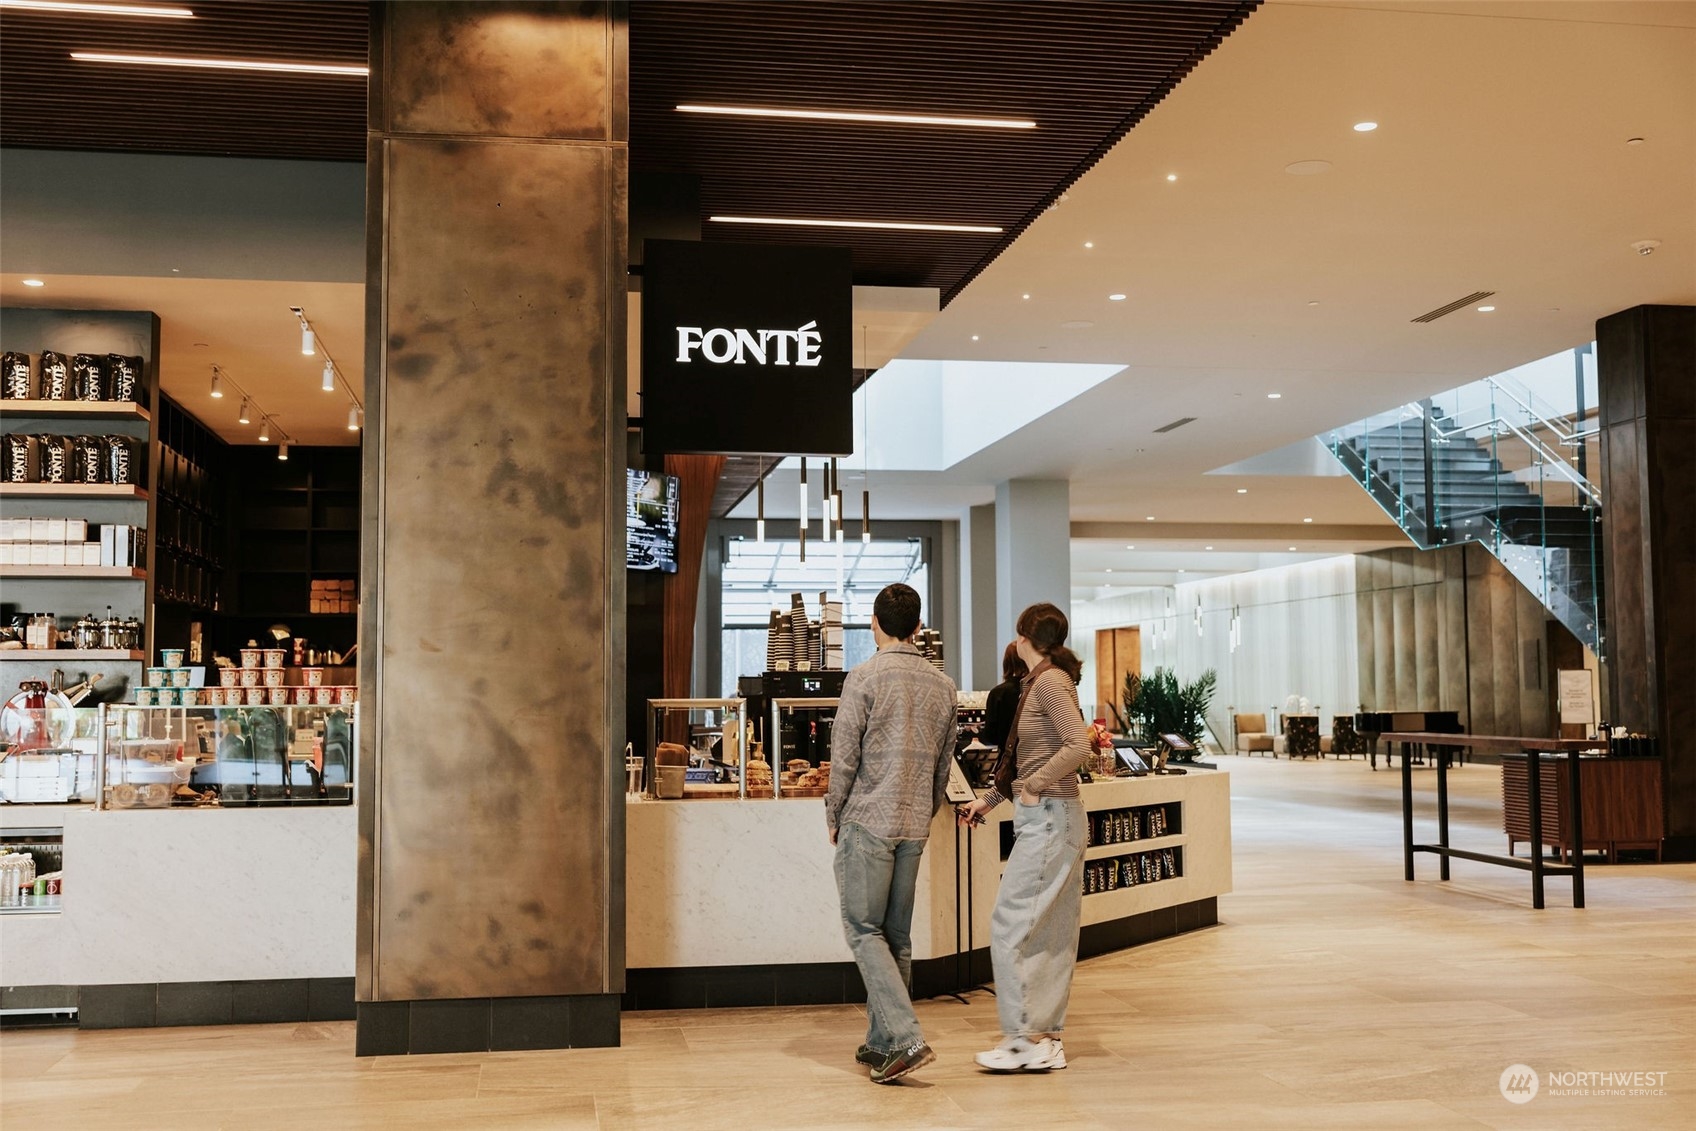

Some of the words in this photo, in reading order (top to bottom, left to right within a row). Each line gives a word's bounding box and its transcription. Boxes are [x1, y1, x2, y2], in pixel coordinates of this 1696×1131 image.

[676, 320, 822, 367] FONTÉ
[13, 364, 26, 399] FONTÉ
[50, 365, 63, 399] FONTÉ
[87, 366, 99, 401] FONTÉ
[121, 366, 132, 401] FONTÉ
[12, 446, 24, 482] FONTÉ
[51, 445, 62, 482] FONTÉ
[85, 446, 97, 482] FONTÉ
[117, 447, 128, 483] FONTÉ
